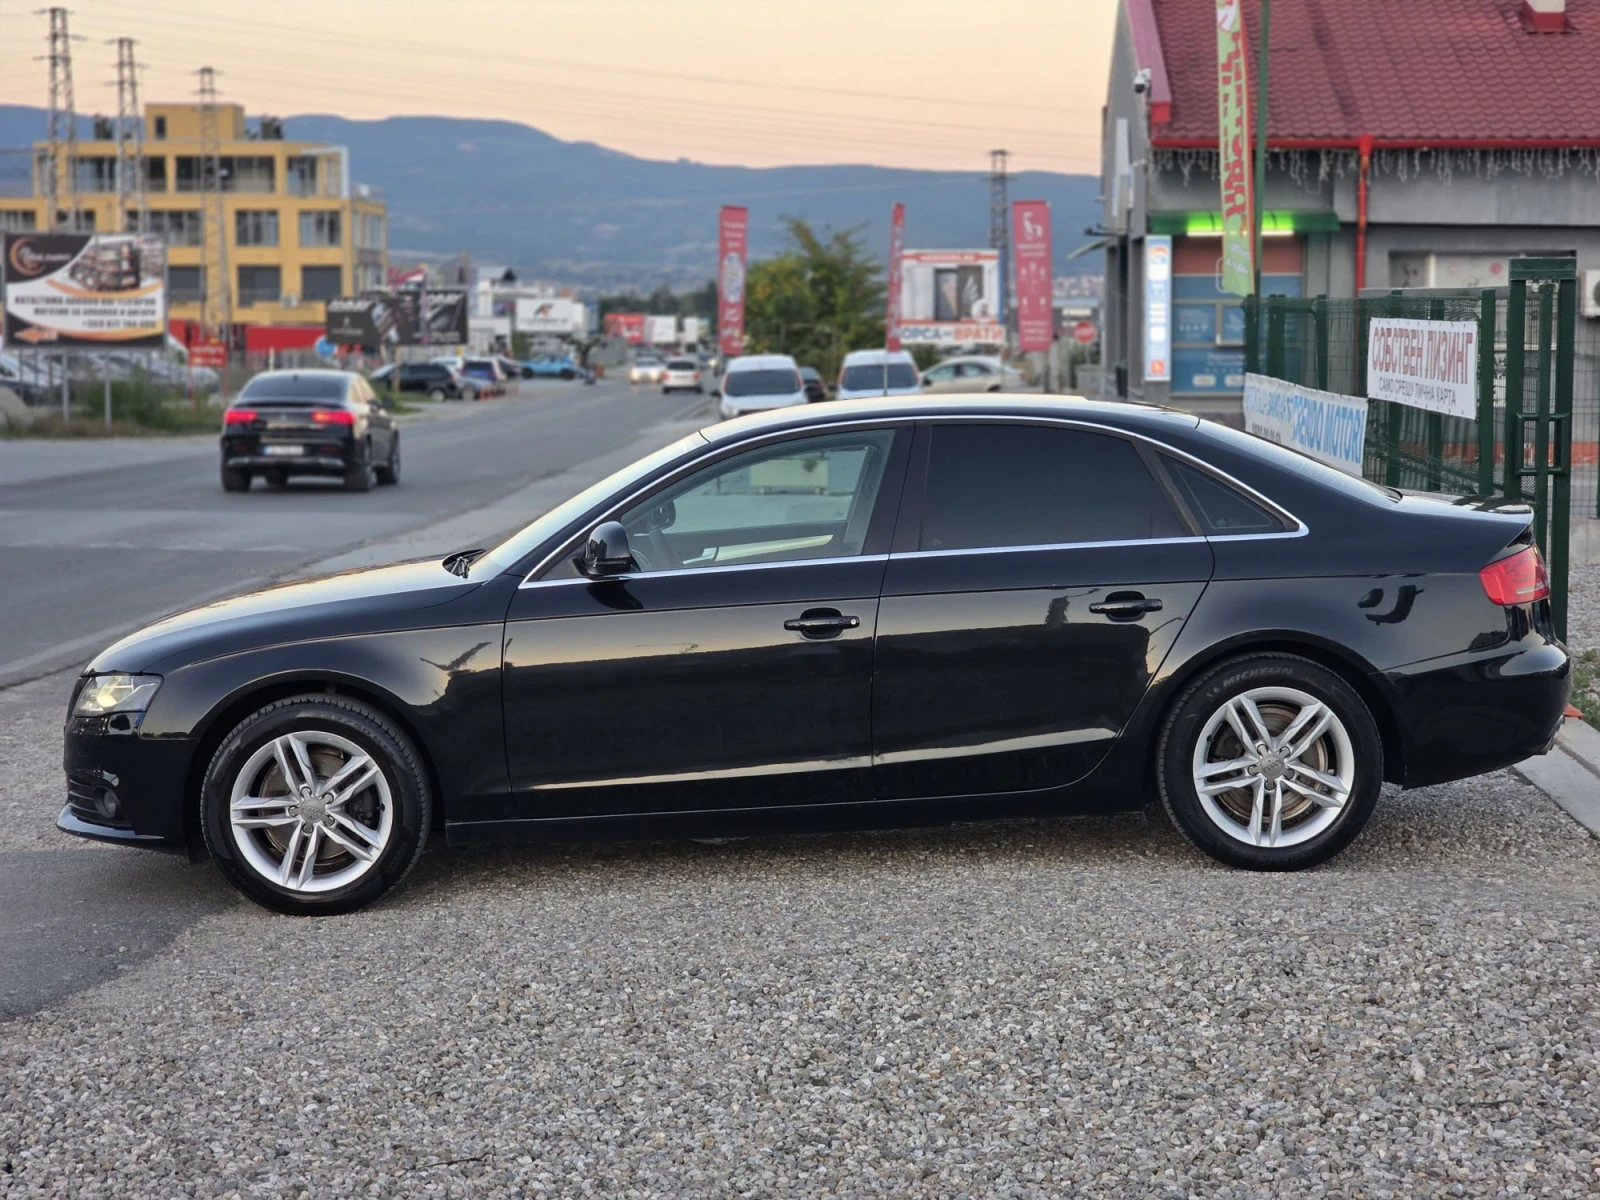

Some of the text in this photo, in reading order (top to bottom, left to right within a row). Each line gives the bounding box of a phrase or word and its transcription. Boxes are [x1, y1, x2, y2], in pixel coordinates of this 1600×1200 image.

[1372, 327, 1473, 385] СОБСТВЕН ЛИЗИНГ
[1379, 377, 1394, 394] САМО
[1415, 382, 1435, 401] ЛИЧНА
[1436, 386, 1457, 406] КАРТА
[1223, 666, 1294, 688] MICHELIN
